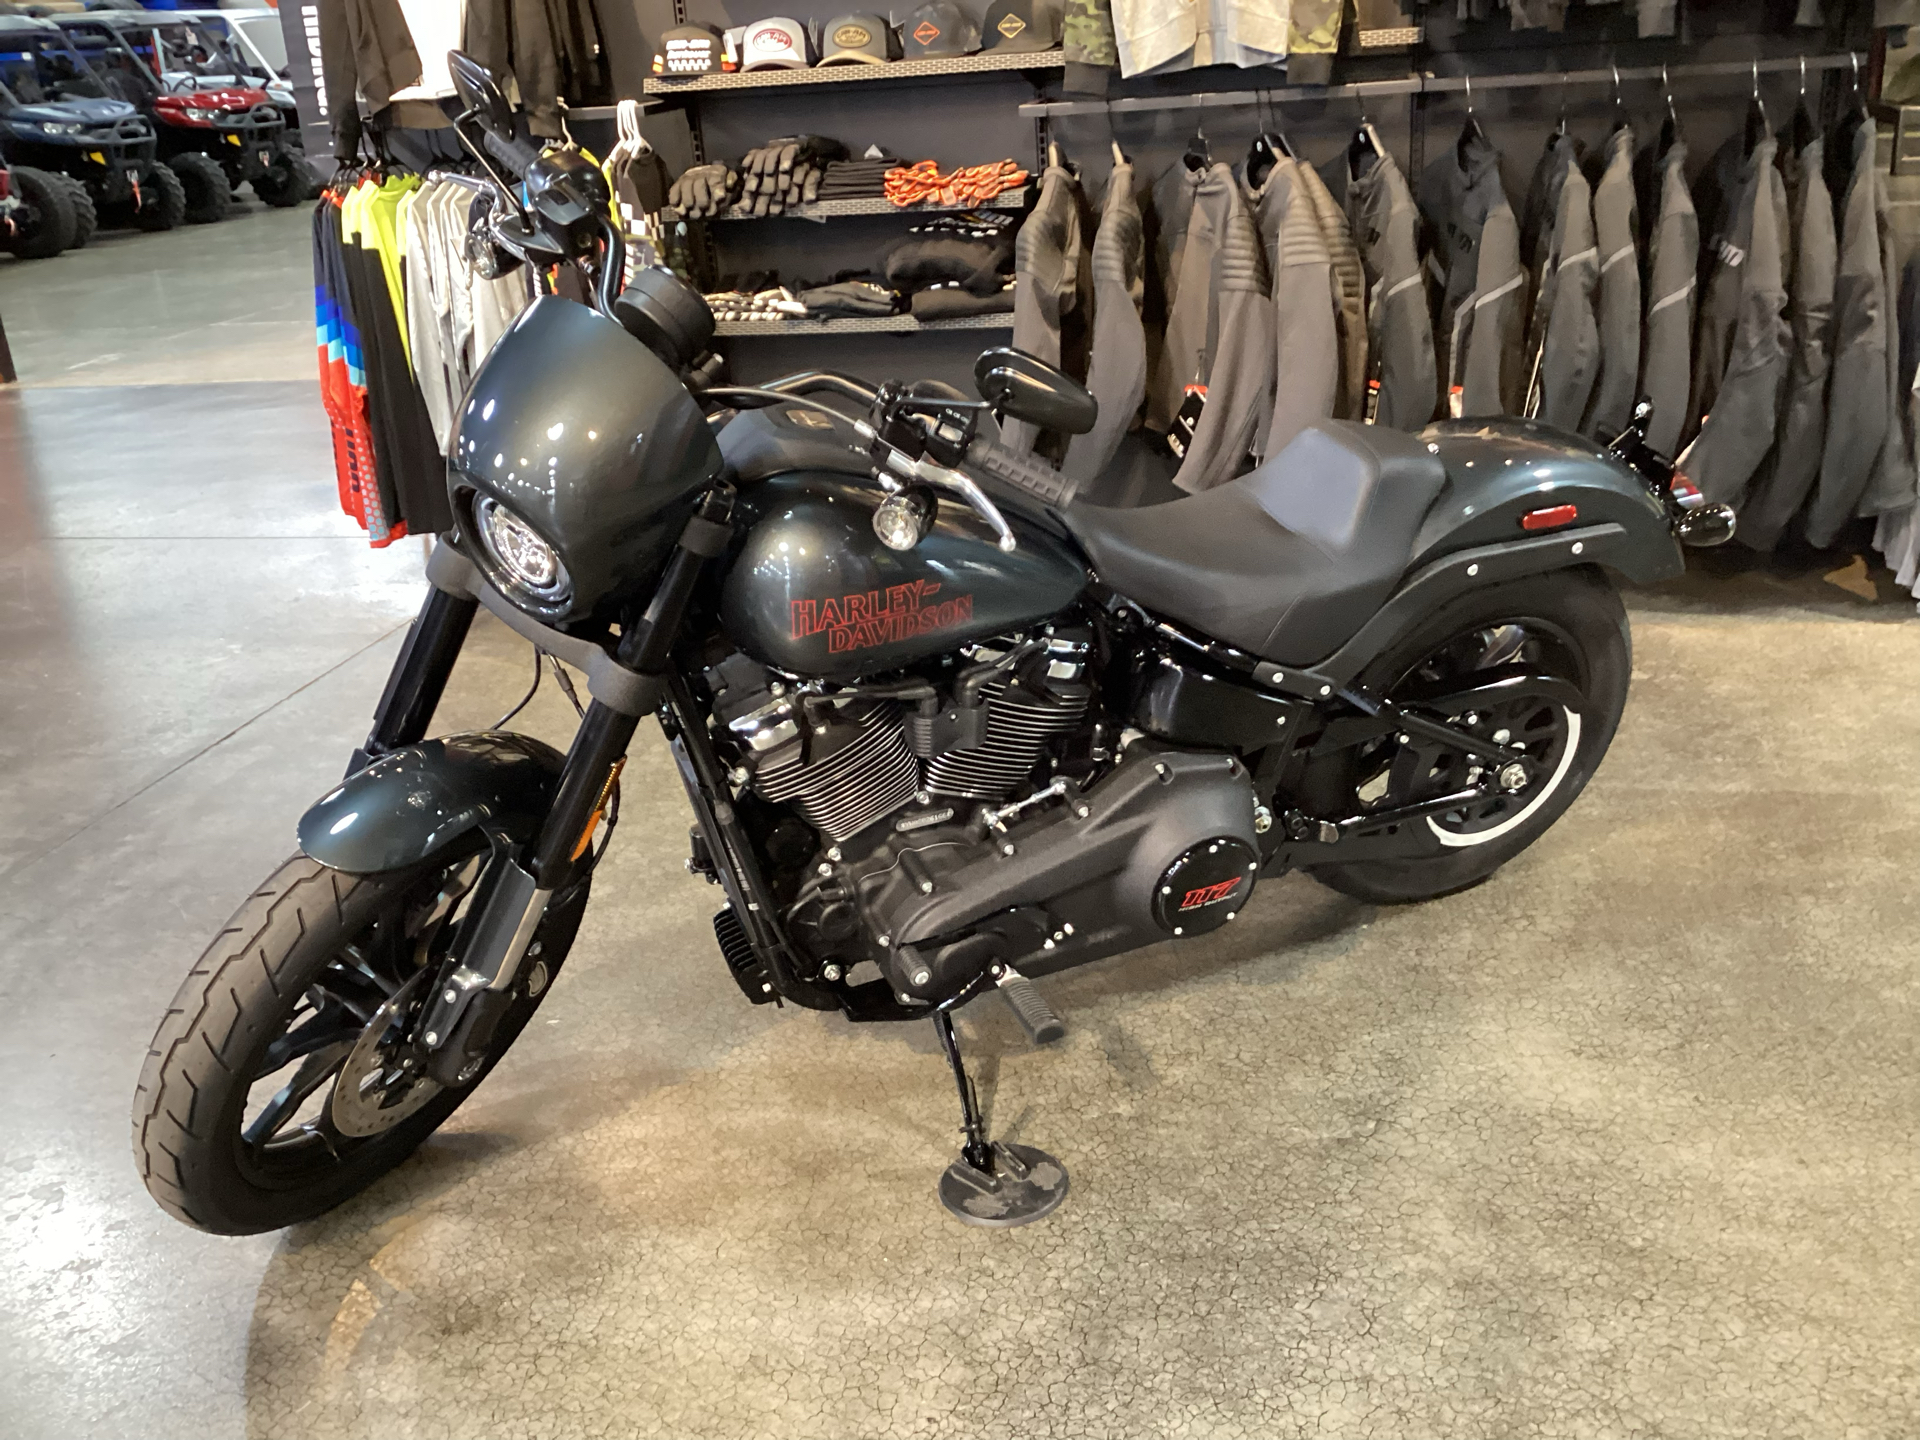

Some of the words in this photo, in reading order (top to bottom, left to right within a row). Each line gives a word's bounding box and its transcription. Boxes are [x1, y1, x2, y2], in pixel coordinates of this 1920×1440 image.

[791, 578, 942, 640] HARLEY-
[828, 594, 974, 654] DAVIDSON
[1181, 876, 1242, 907] 117
[1203, 893, 1238, 906] OUTPUT
